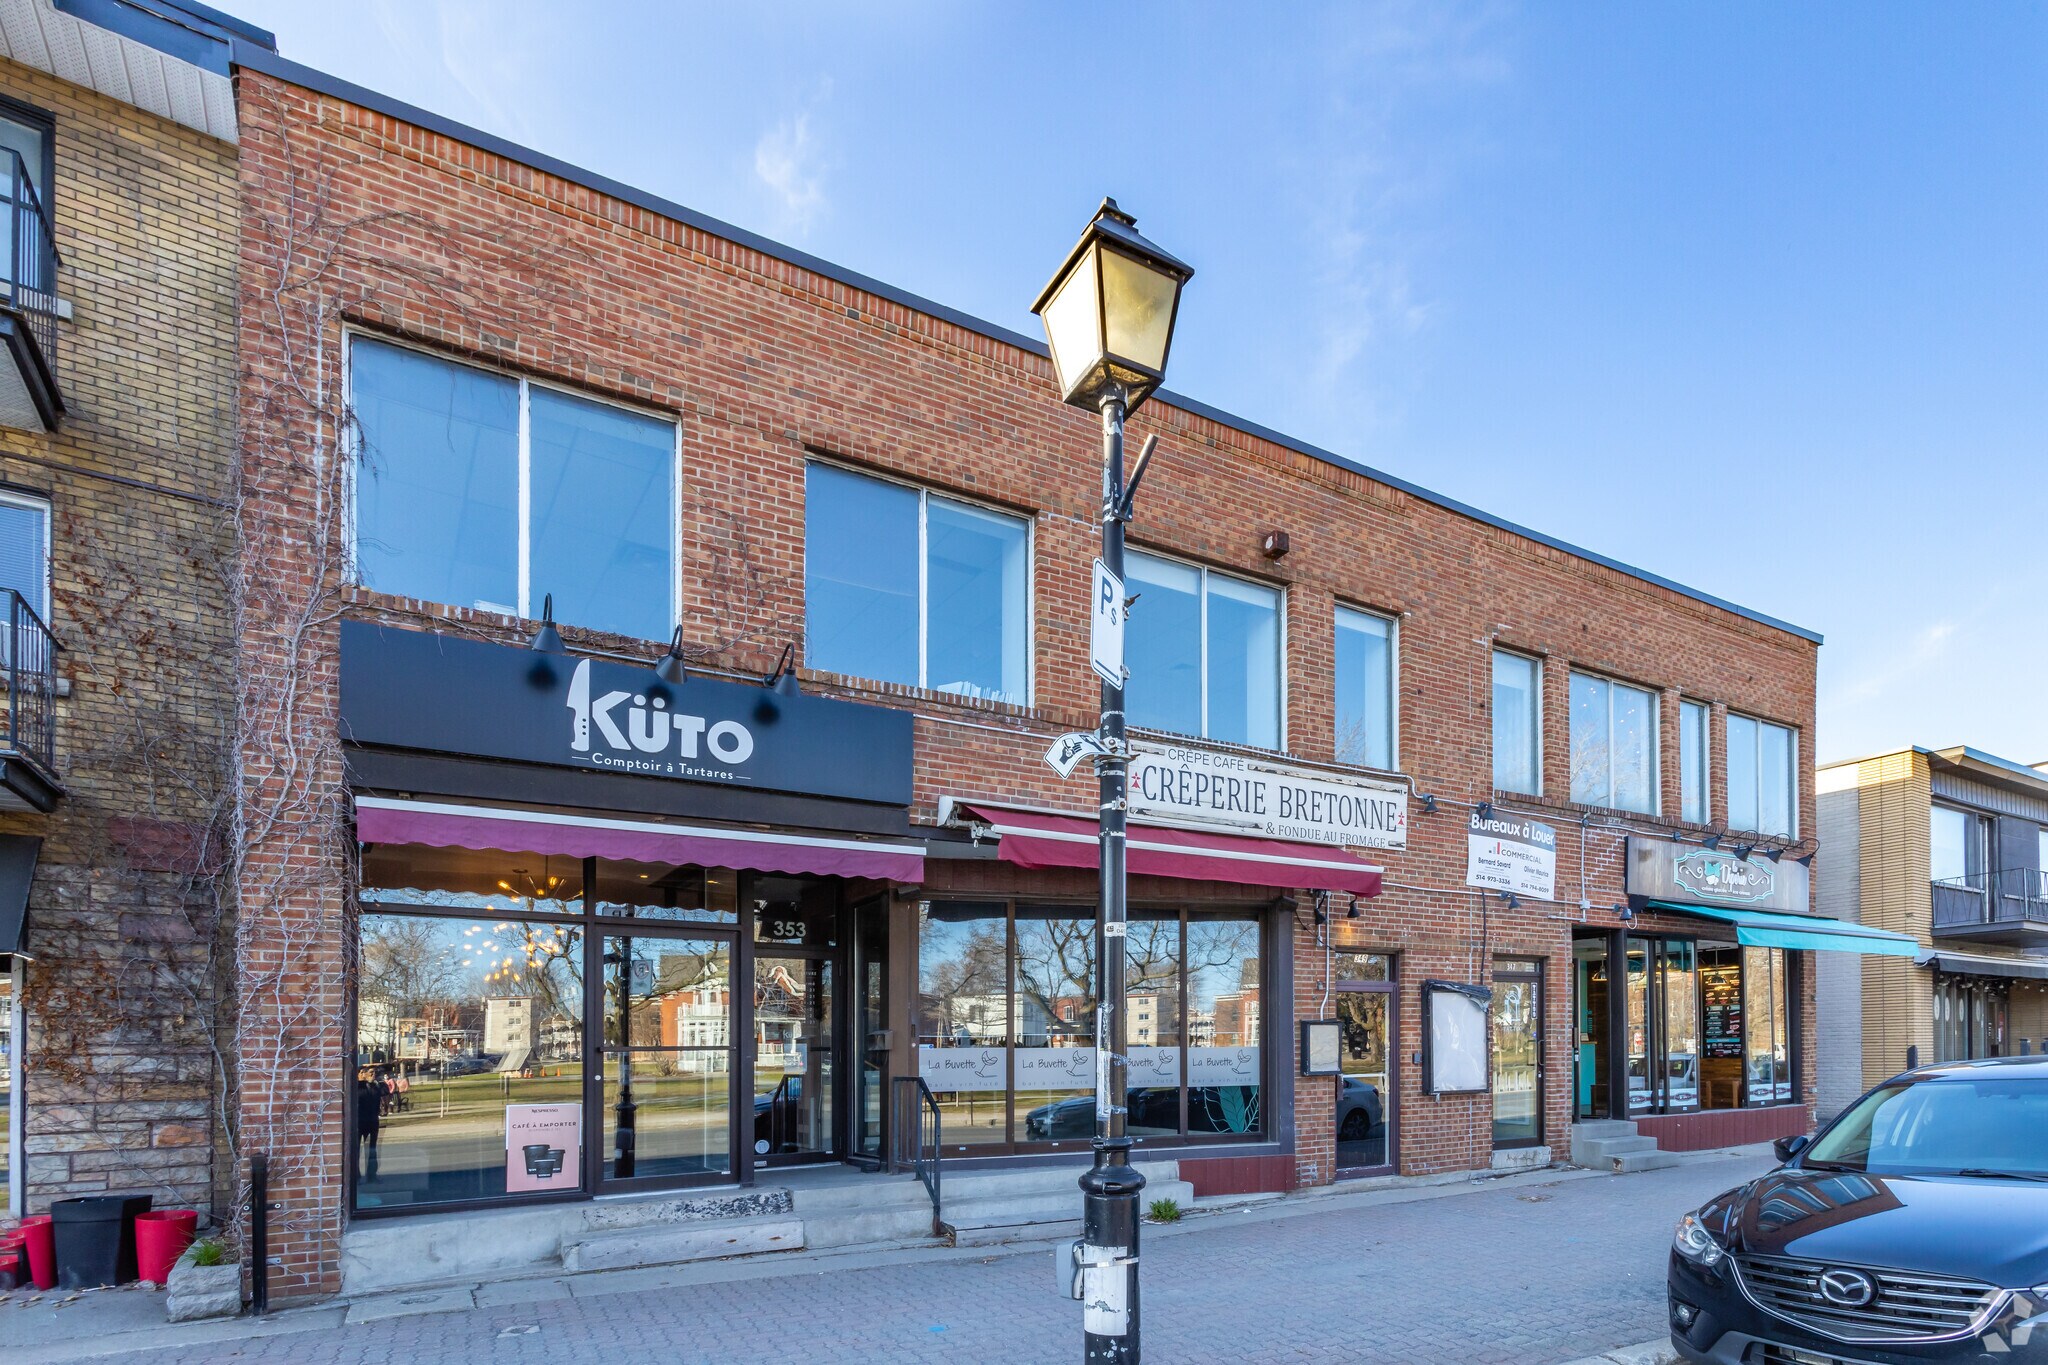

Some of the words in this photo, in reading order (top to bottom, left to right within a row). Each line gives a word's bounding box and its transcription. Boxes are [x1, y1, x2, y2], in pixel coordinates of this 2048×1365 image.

[1101, 576, 1113, 615] P
[592, 753, 661, 771] Comptoir
[667, 763, 673, 772] à
[679, 763, 733, 780] Tartares
[1168, 748, 1210, 766] CRÊPE
[1213, 756, 1244, 771] CAFÉ
[1142, 764, 1266, 815] CRÊPERIE
[1279, 785, 1397, 832] BRETONNE
[1266, 822, 1275, 834] &
[1278, 825, 1320, 840] FONDUE
[1323, 831, 1337, 842] AU
[1340, 832, 1386, 848] FROMAGE
[1471, 813, 1520, 836] Bureaux
[1523, 822, 1529, 838] à
[1532, 826, 1554, 846] Louer
[1501, 849, 1542, 864] COMMERCIAL
[774, 921, 806, 937] 353
[928, 1060, 940, 1069] La
[945, 1059, 976, 1069] Buvette
[1022, 1060, 1033, 1069] La
[1038, 1059, 1067, 1068] Buvette
[1192, 1058, 1202, 1066] La
[1206, 1058, 1233, 1066] Buvette
